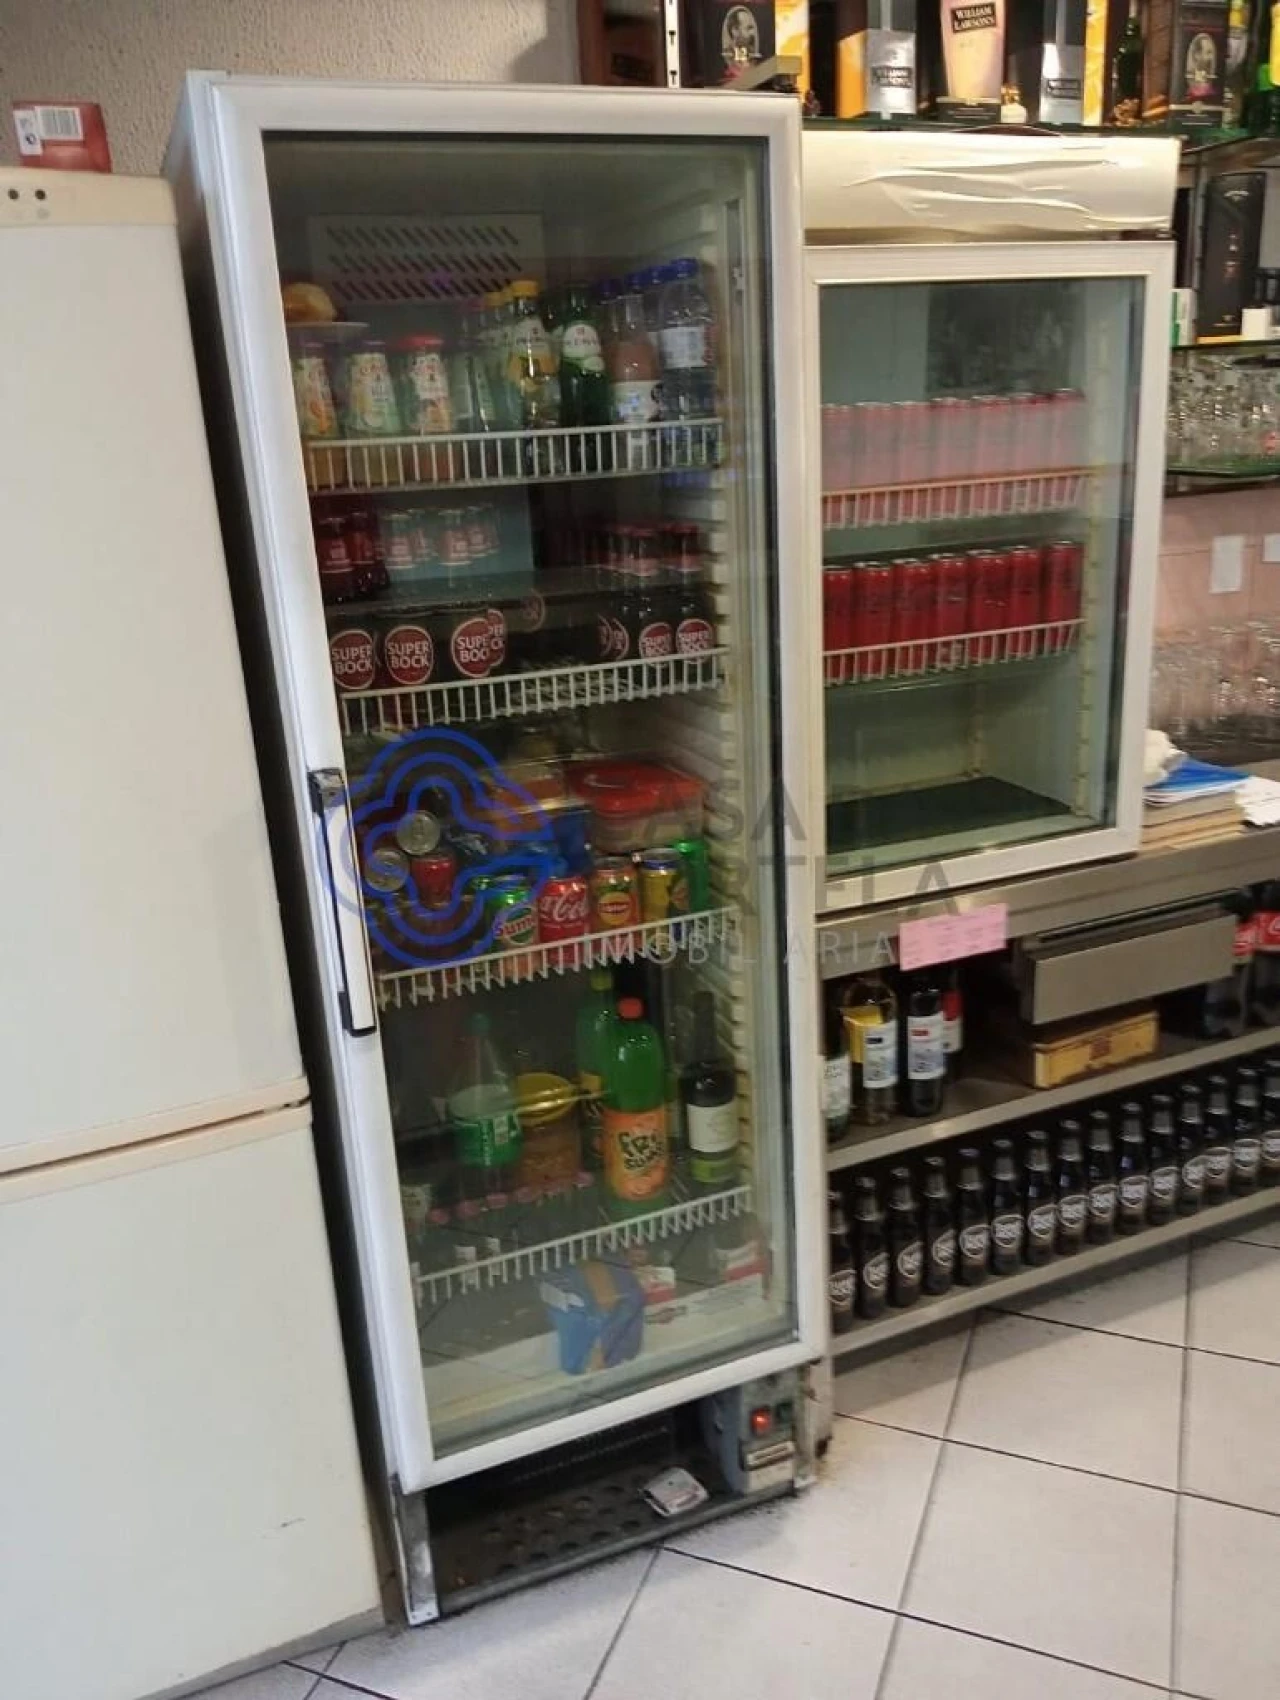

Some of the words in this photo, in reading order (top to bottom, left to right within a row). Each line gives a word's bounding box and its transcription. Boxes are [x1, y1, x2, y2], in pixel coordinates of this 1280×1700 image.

[956, 6, 993, 20] WILLIAM
[331, 645, 373, 661] SUPER
[387, 640, 429, 657] SUPER
[334, 658, 373, 675] BOCK
[390, 654, 428, 669] BOCK
